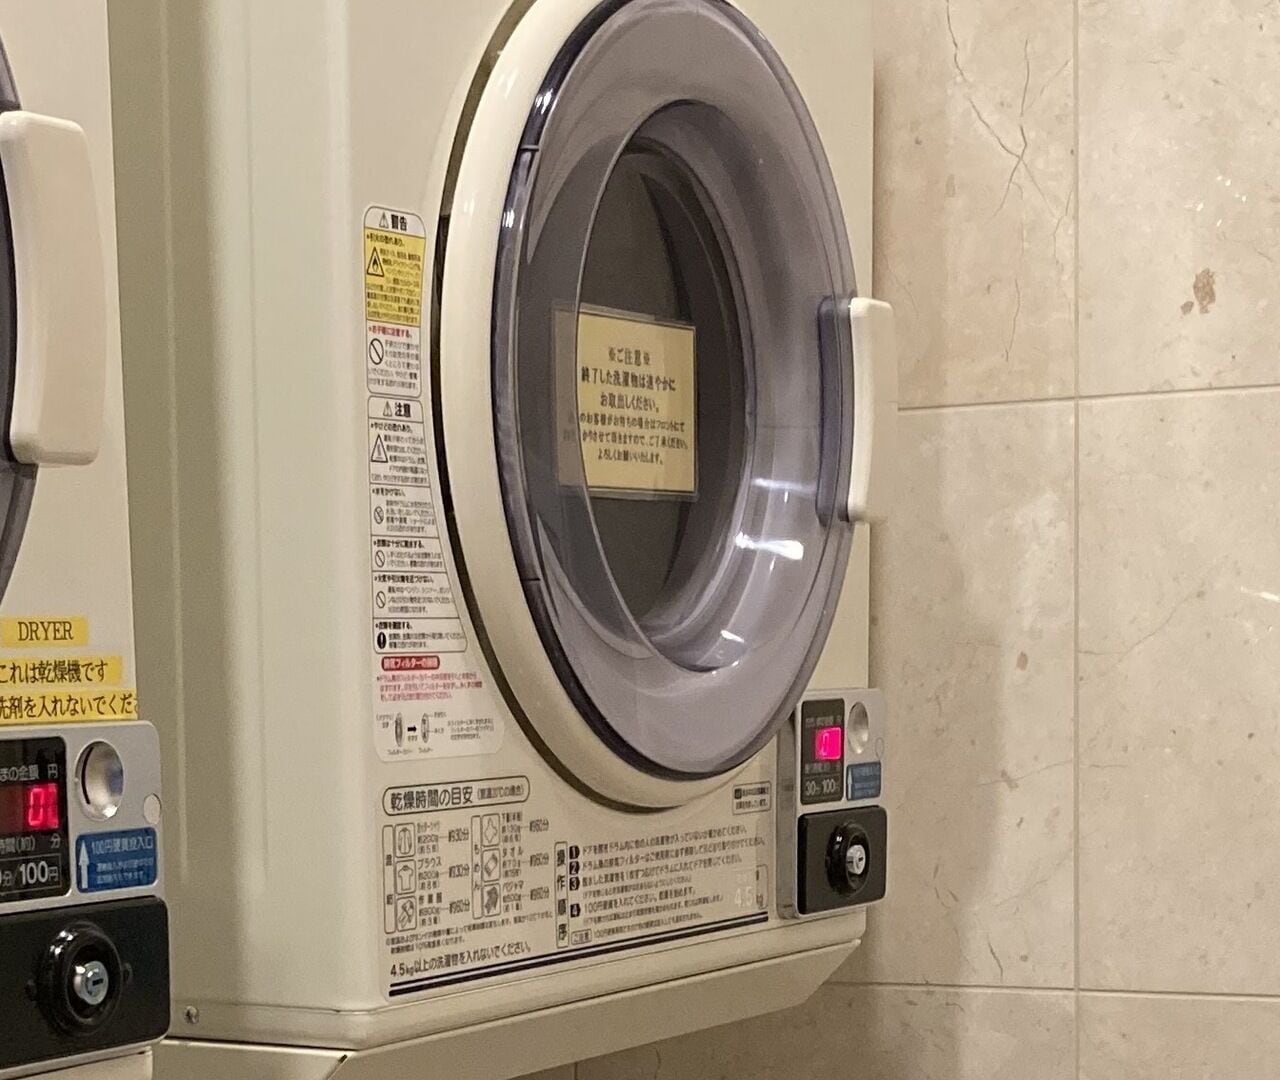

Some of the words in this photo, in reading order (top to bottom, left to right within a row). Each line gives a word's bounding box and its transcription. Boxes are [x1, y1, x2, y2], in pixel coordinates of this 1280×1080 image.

[18, 621, 74, 641] DRYER
[390, 786, 473, 812] 乾燥時間の目安
